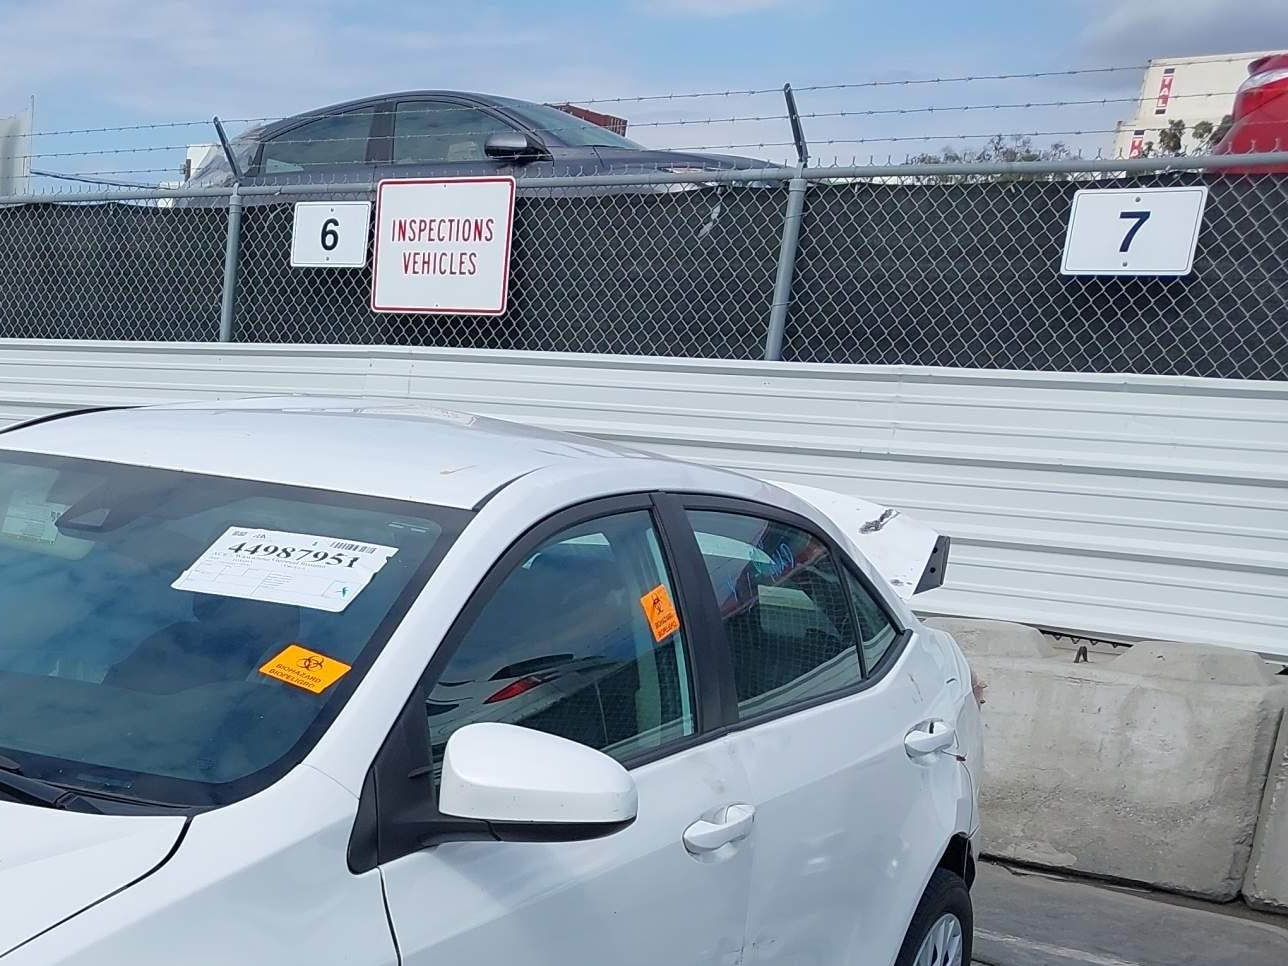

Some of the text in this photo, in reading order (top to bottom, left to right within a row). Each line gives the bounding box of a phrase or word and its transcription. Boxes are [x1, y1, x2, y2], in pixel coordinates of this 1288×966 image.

[1157, 75, 1173, 107] TAL
[320, 217, 340, 251] 6
[391, 217, 495, 242] INSPECTIONS
[1119, 211, 1151, 253] 7
[402, 251, 478, 276] VEHICLES
[228, 541, 360, 569] 44987951
[268, 668, 316, 689] BIOPELIGRO
[275, 663, 322, 684] BIOHAZARD
